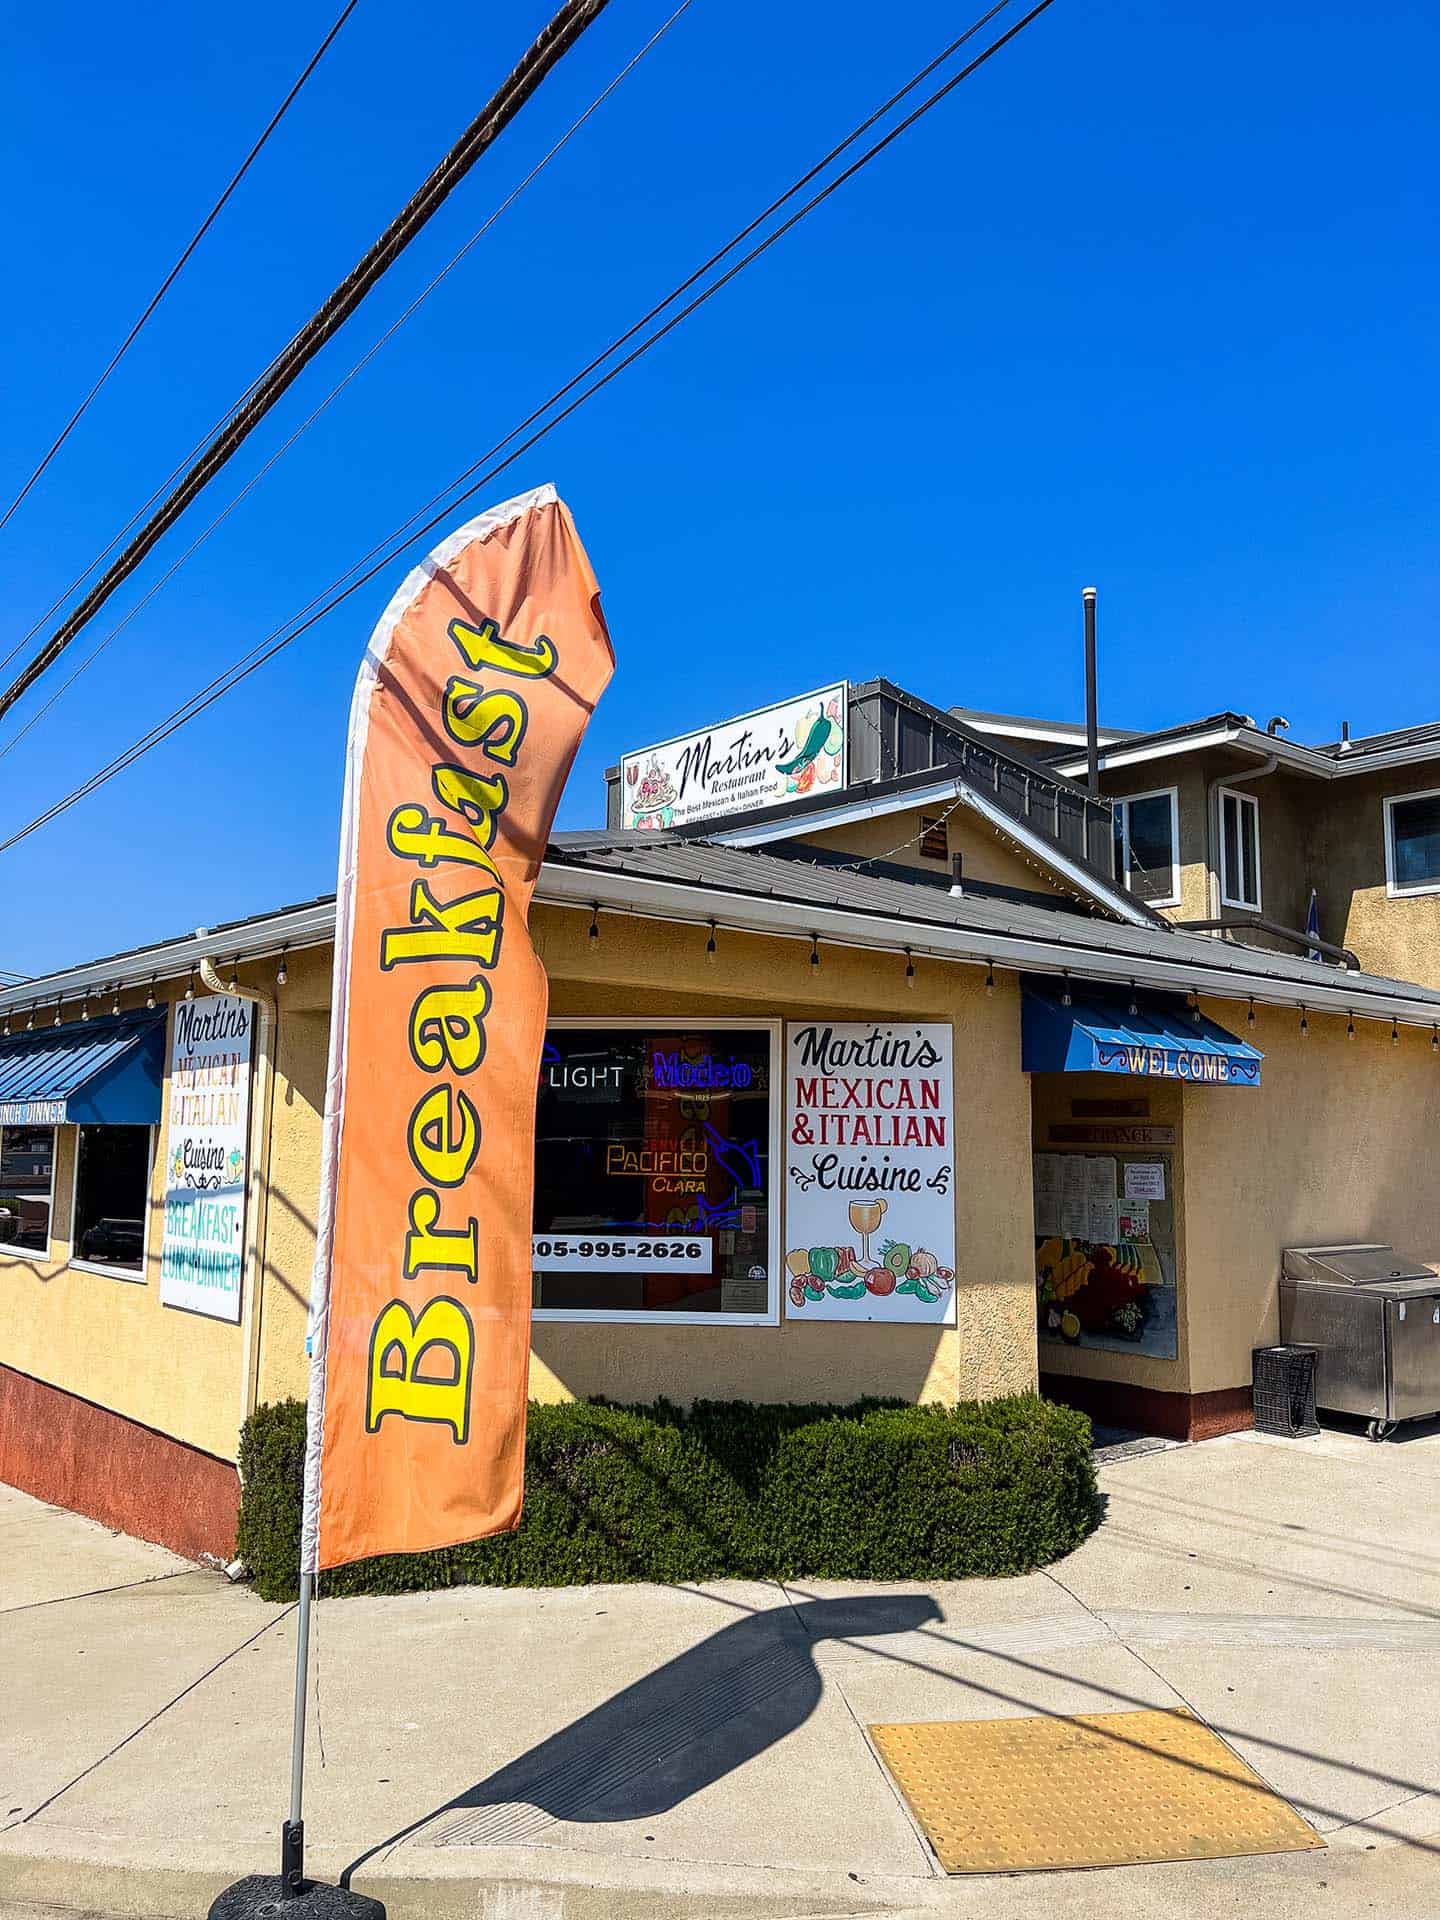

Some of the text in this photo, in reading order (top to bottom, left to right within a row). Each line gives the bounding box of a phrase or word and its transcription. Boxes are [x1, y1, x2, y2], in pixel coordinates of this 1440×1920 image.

[675, 728, 795, 800] Martin's
[673, 808, 686, 817] The
[687, 803, 702, 815] Best
[702, 797, 730, 811] Mexican
[737, 787, 760, 801] Italian
[759, 782, 778, 794] Food
[711, 769, 767, 795] Restaurant
[177, 997, 249, 1056] Martin's
[365, 617, 559, 1445] Breakfast
[793, 1026, 943, 1076] Martin's
[1125, 1047, 1229, 1082] WELCOME
[176, 1052, 241, 1091] MEXICAN
[549, 1066, 625, 1088] LIGHT
[795, 1077, 940, 1110] MEXICAN
[27, 1101, 65, 1122] DINNER
[183, 1138, 225, 1172] Cuisine
[607, 1145, 708, 1174] PACIFICO
[812, 1153, 922, 1192] Cuisine
[652, 1177, 706, 1193] CLARA
[166, 1199, 236, 1245] BREAKFAST
[197, 1247, 240, 1294] DINNER
